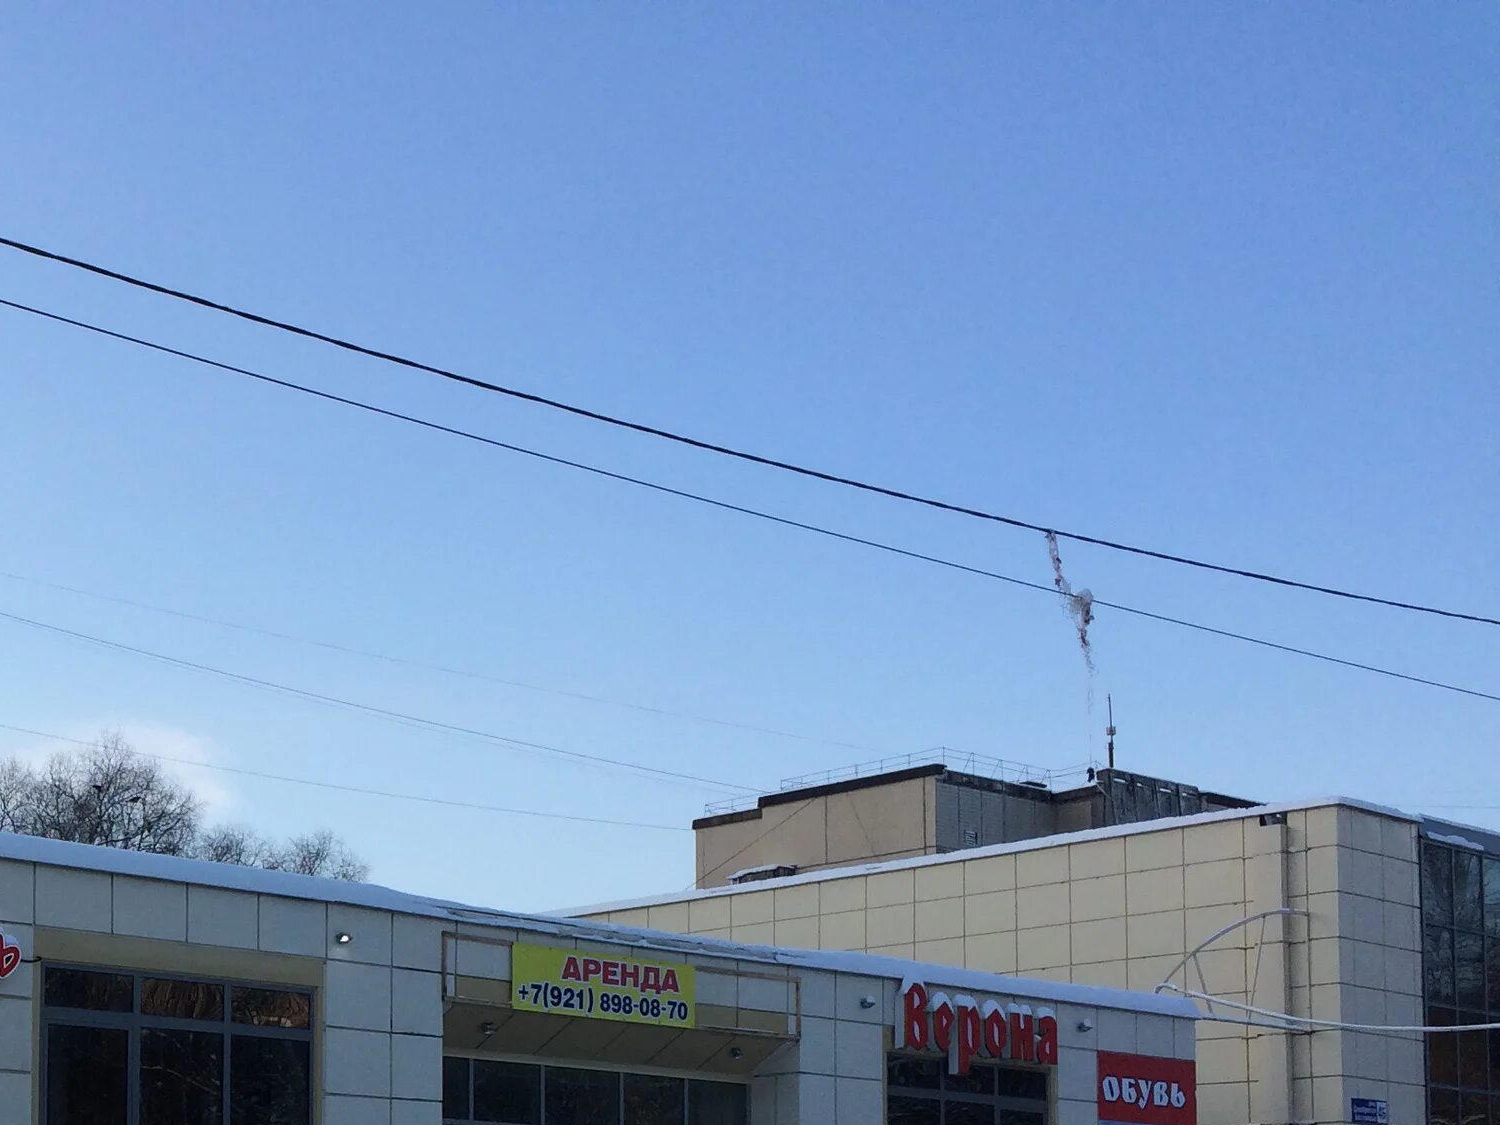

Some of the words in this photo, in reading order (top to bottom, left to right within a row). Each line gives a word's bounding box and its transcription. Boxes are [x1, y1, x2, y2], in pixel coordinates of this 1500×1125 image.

[562, 956, 680, 995] АРЕНДА
[518, 982, 595, 1013] +7(921)
[600, 993, 688, 1021] 898-08-70
